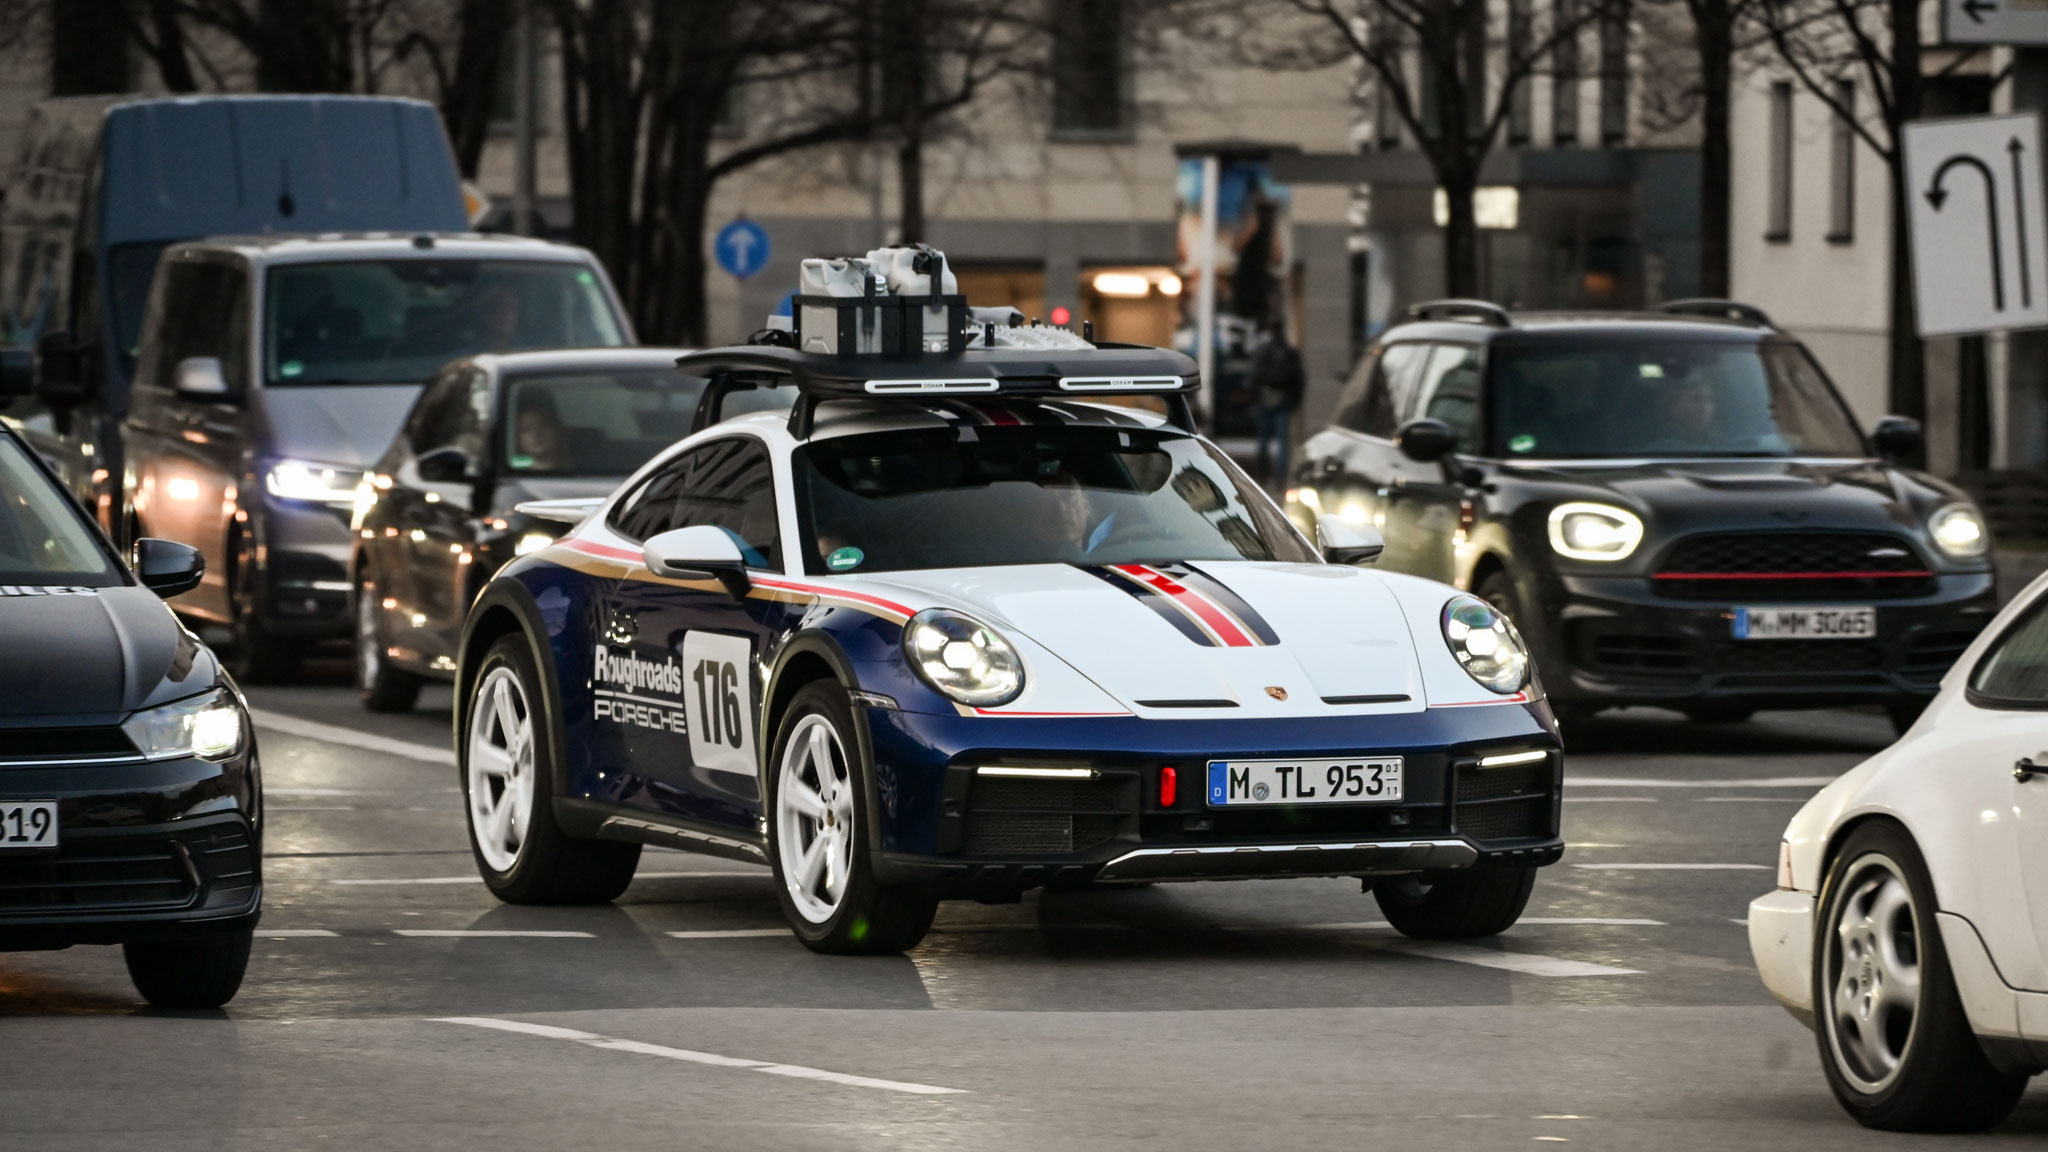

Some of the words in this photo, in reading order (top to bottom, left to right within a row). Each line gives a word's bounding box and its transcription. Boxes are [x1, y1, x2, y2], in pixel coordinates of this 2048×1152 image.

[0, 585, 98, 597] ILES
[594, 644, 682, 694] Roughroads
[594, 699, 687, 735] PORSCHE
[693, 659, 743, 750] 176
[1229, 766, 1250, 799] M
[1275, 766, 1316, 799] TL
[1326, 764, 1383, 798] 953
[1385, 763, 1399, 773] 03
[1214, 787, 1222, 797] D
[1386, 786, 1398, 796] 11
[0, 807, 51, 842] 19
